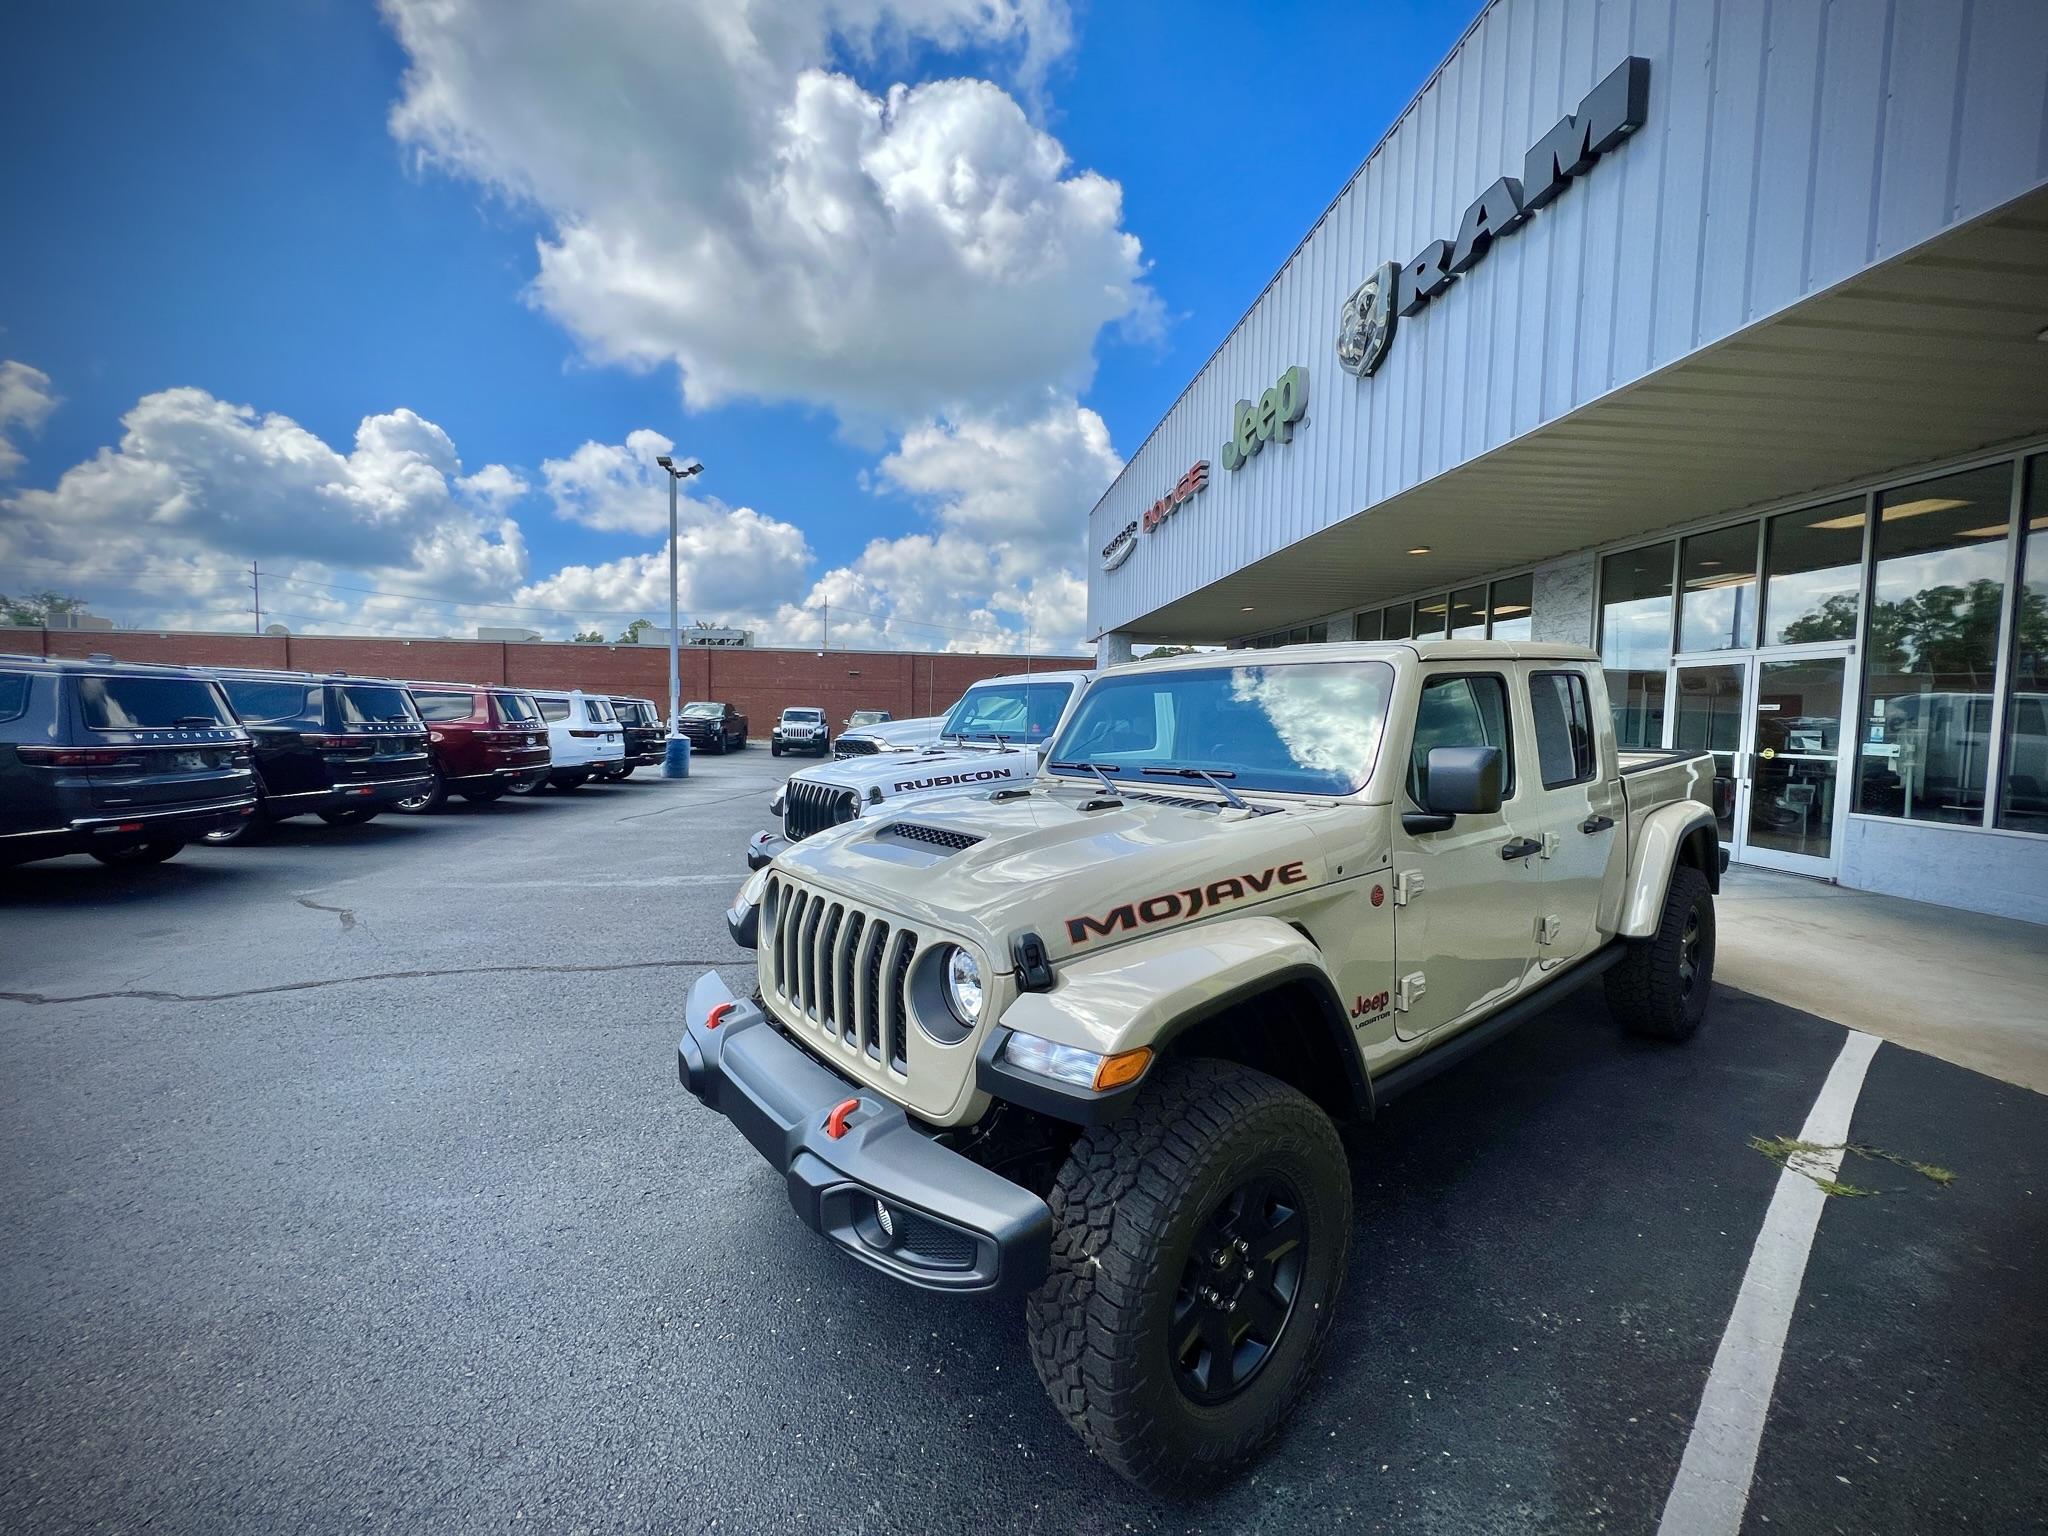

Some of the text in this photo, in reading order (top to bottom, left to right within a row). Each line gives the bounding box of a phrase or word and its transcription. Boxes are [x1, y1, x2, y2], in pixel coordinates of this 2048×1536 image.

[1398, 56, 1650, 317] RAM
[1222, 366, 1309, 471] Jeep
[1142, 459, 1210, 534] DODGE
[894, 768, 1012, 793] RUBICON
[1064, 861, 1308, 944] MOJAVE
[1350, 990, 1389, 1018] Jeep
[1355, 1010, 1391, 1030] LADIATOR
